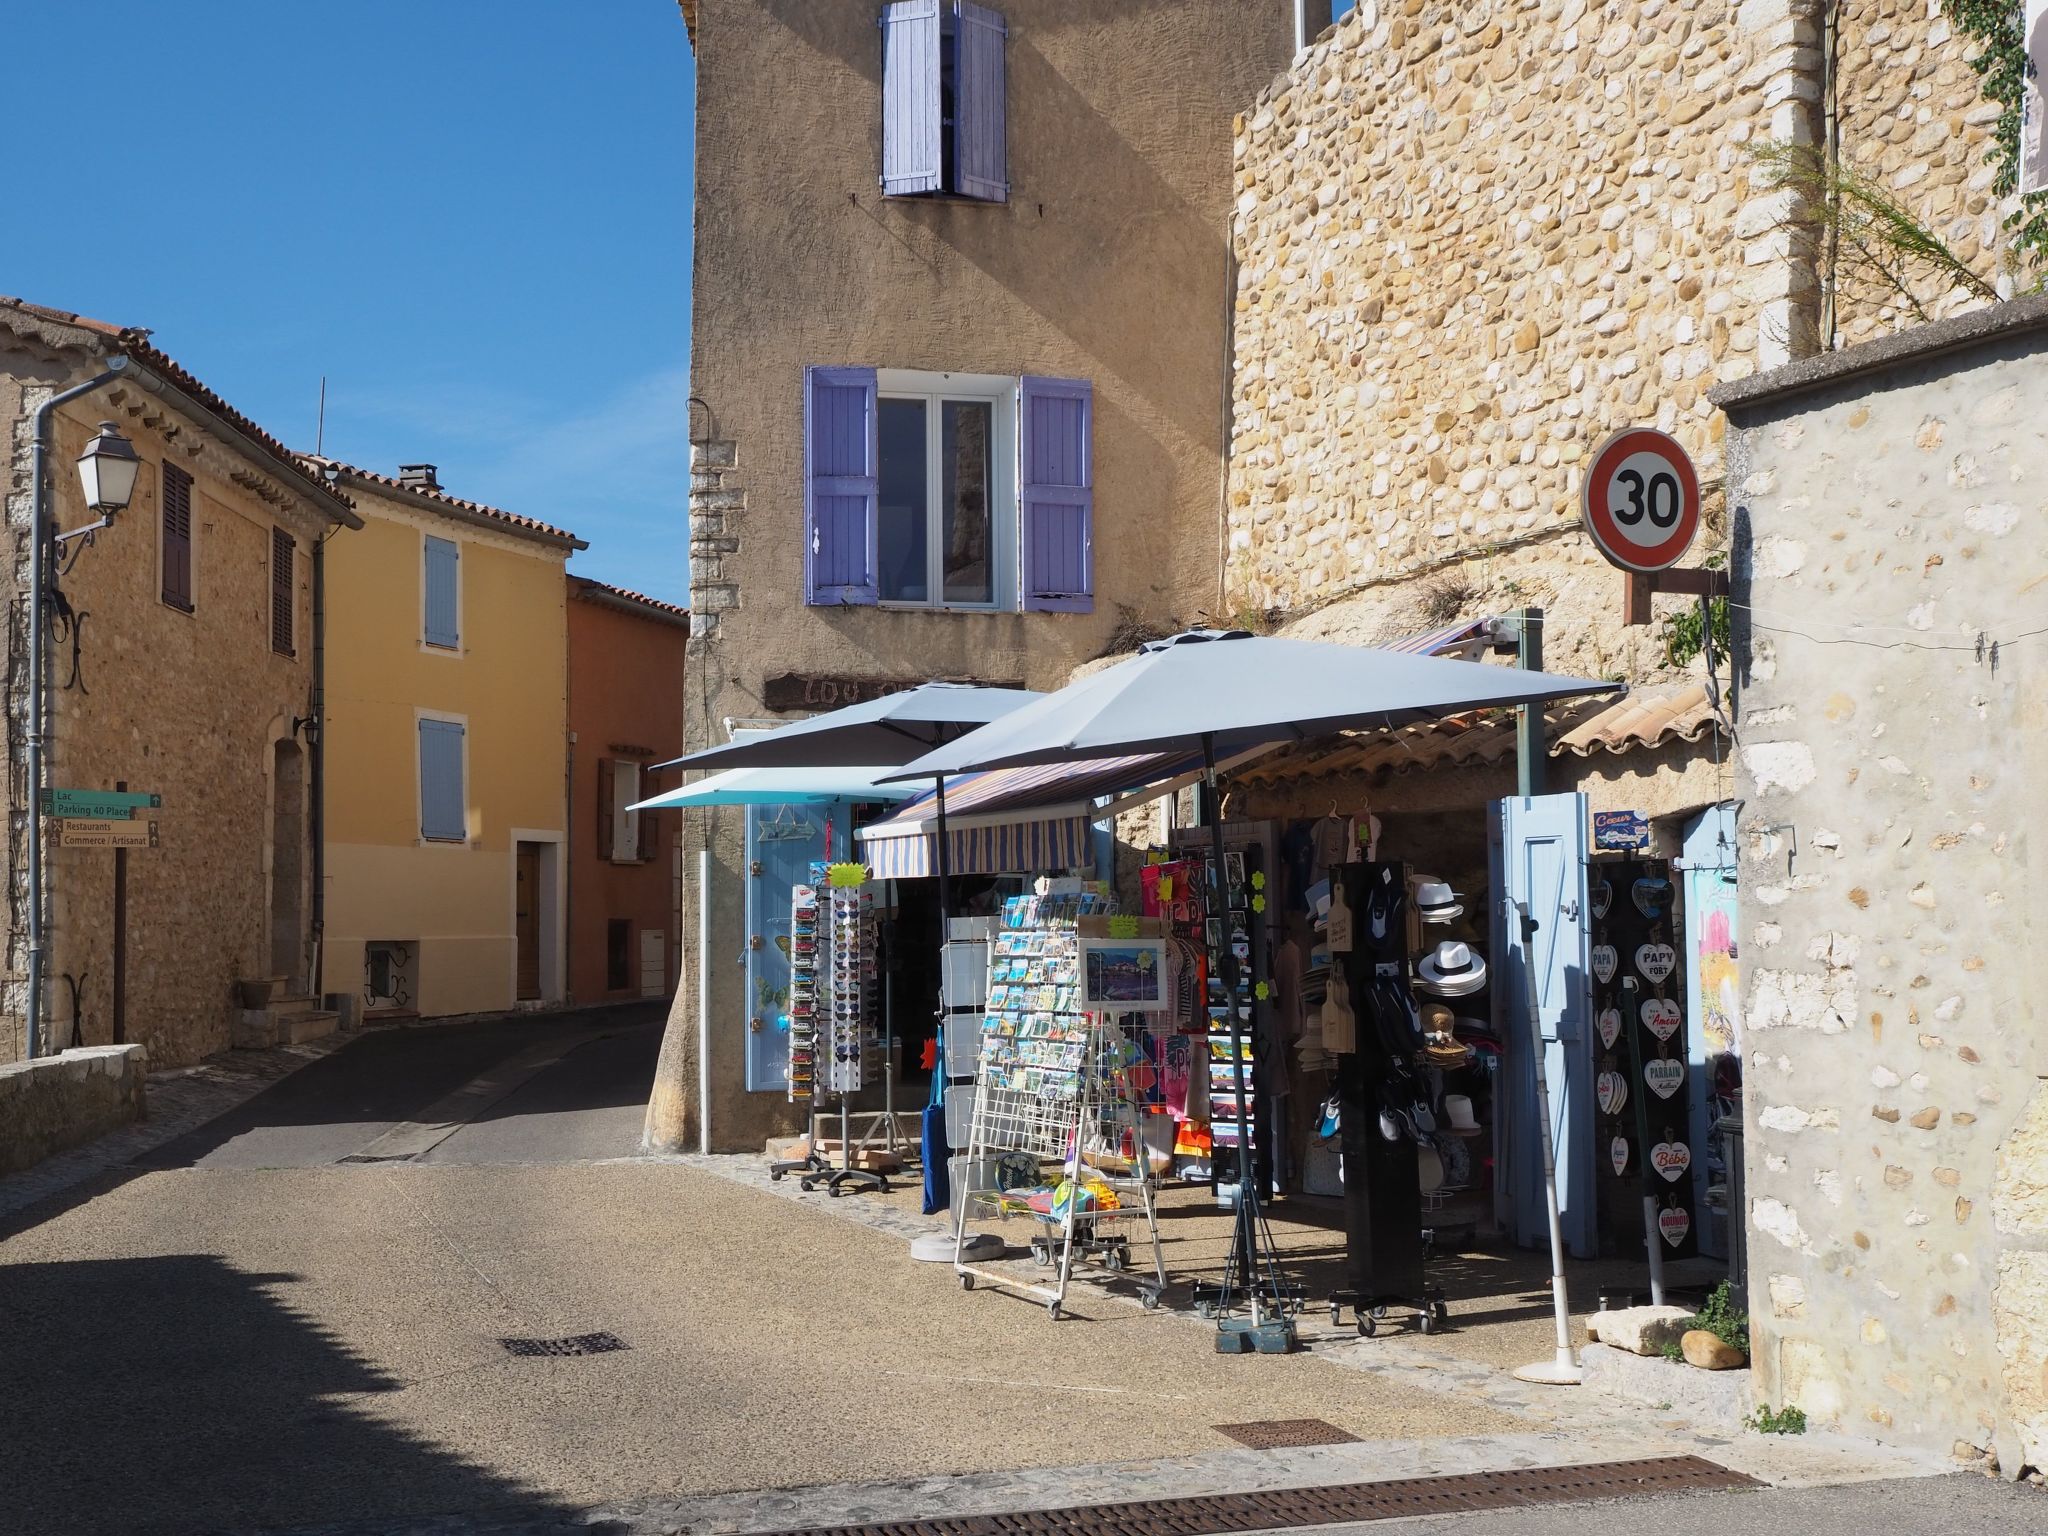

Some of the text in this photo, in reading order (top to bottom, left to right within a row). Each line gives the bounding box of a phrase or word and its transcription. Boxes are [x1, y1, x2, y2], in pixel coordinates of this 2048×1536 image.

[1614, 469, 1679, 528] 30
[57, 791, 72, 801] Lac
[58, 804, 91, 817] Parking
[93, 806, 104, 815] 40
[66, 821, 111, 832] Restaurants
[64, 835, 106, 845] Commerce
[111, 835, 147, 845] Artisanat
[1593, 953, 1611, 966] PAPA
[1643, 952, 1674, 963] PAPY
[1649, 966, 1669, 976] FORT
[1652, 1013, 1681, 1026] Amour
[1650, 1065, 1682, 1079] PARRAIN
[1655, 1151, 1688, 1168] Bébé
